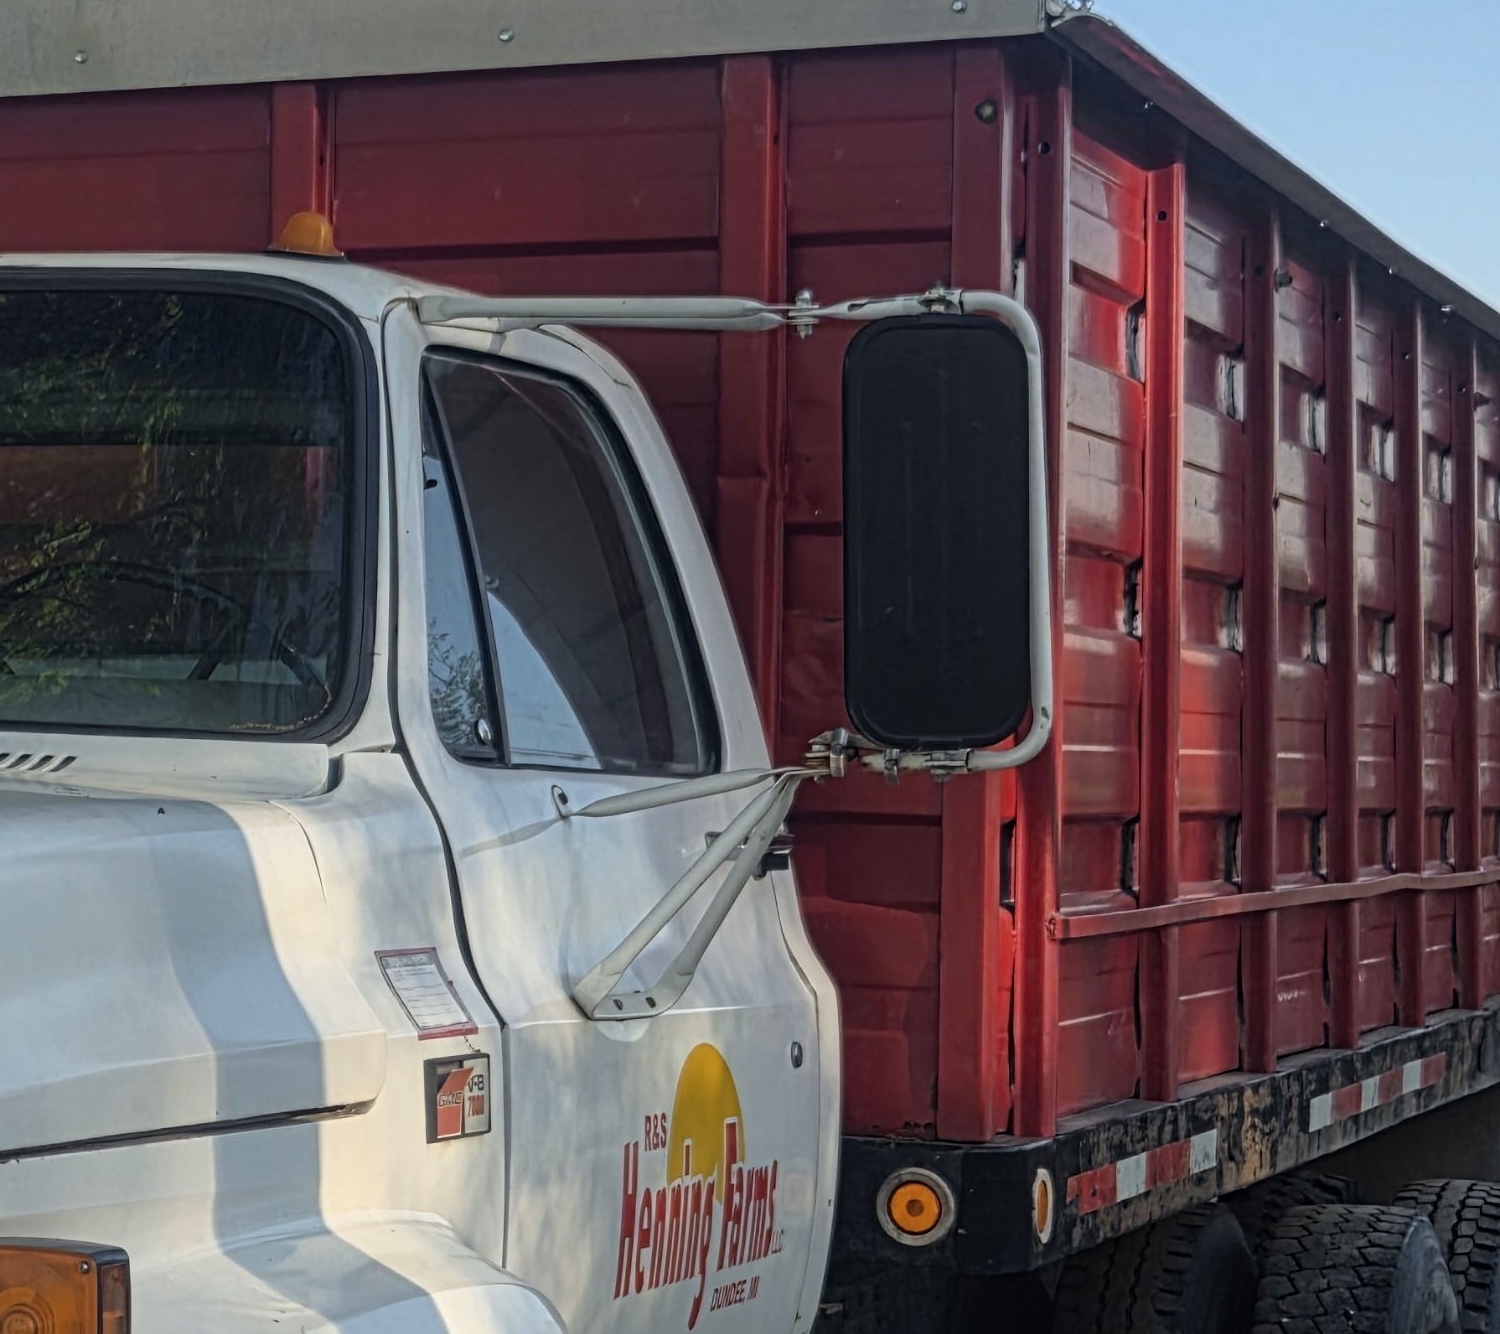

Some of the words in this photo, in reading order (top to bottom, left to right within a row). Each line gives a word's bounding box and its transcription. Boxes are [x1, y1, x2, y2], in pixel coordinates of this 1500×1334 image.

[439, 1092, 464, 1107] GMC
[643, 1112, 668, 1152] R&S
[613, 1140, 716, 1331] Henning
[716, 1118, 778, 1273] Farms
